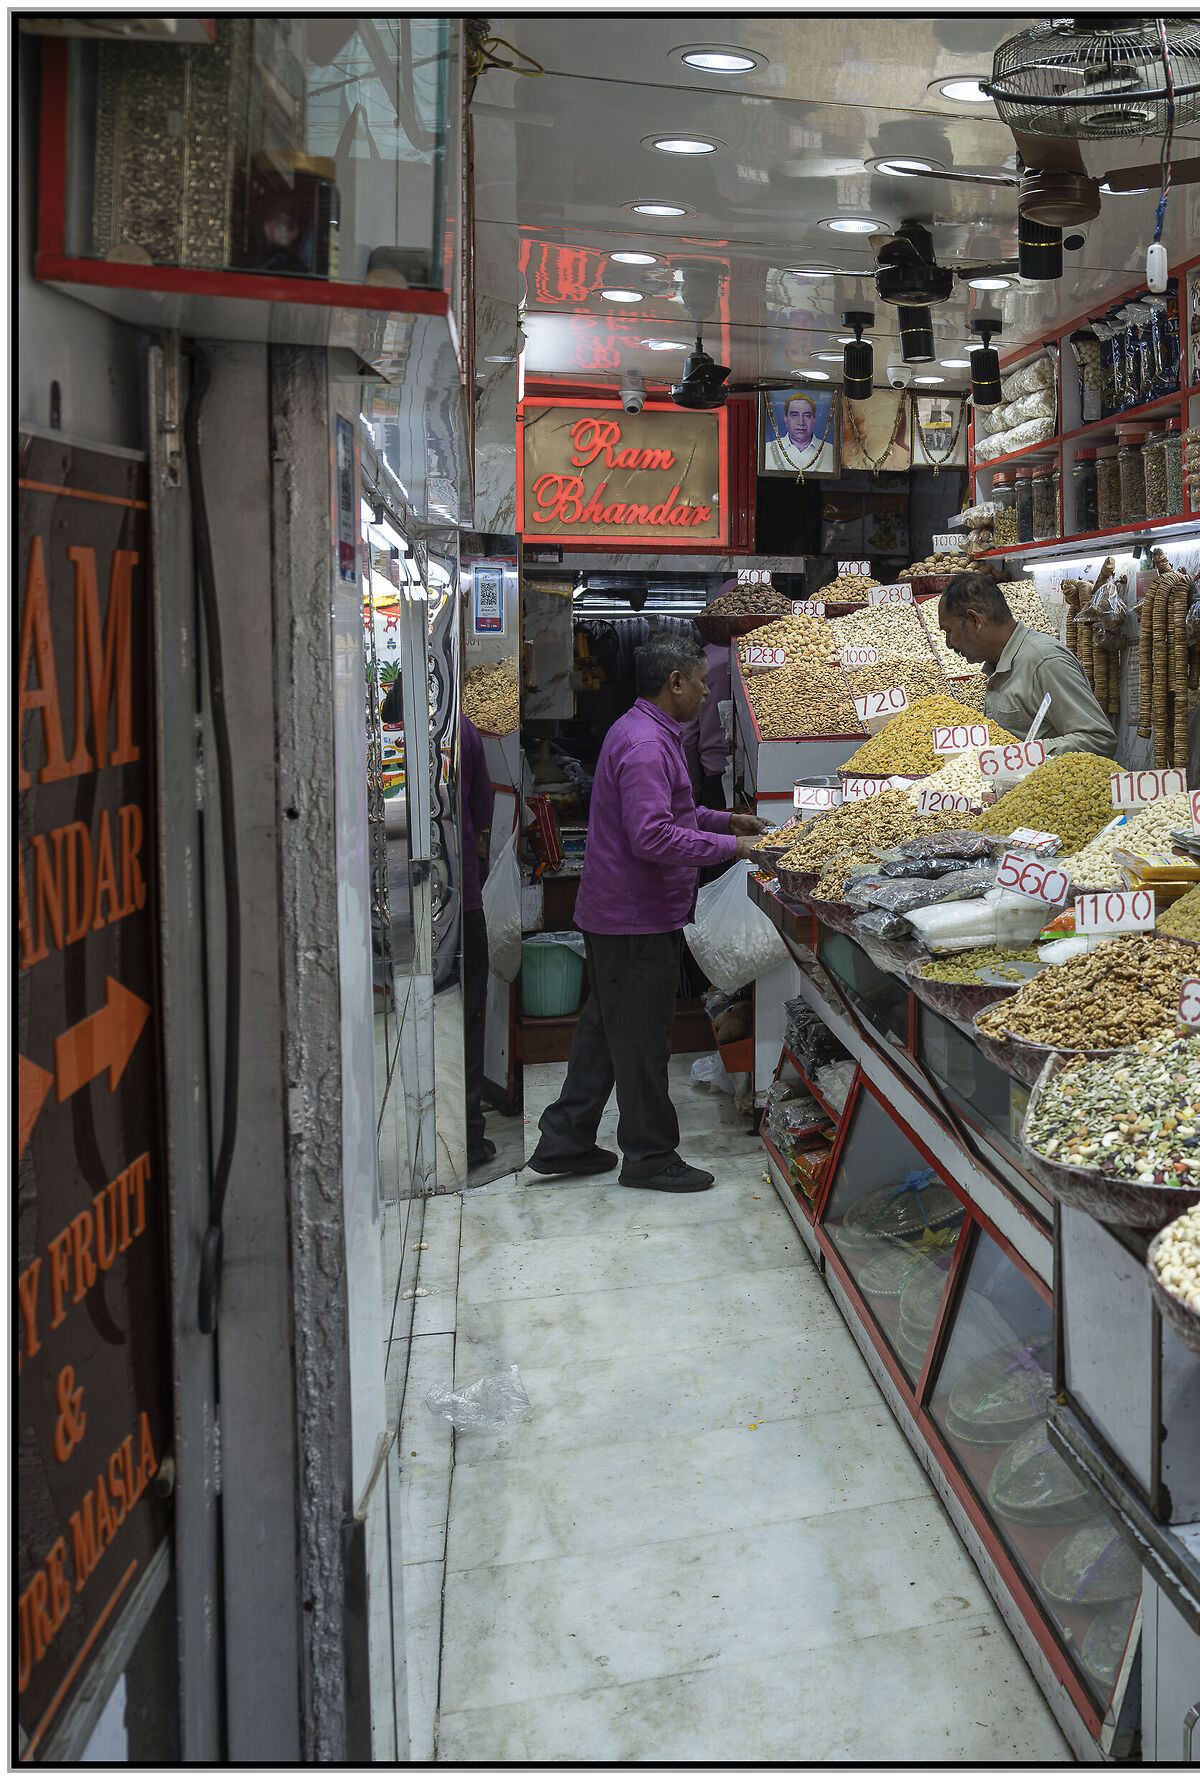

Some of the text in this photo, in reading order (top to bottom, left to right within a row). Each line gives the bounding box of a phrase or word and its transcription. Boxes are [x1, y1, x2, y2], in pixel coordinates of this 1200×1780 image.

[570, 417, 677, 471] Ram
[532, 472, 713, 527] Bhandar
[737, 569, 772, 585] 400
[837, 561, 871, 577] 400
[791, 600, 826, 618] 680
[869, 584, 914, 606] 1280
[745, 647, 786, 666] 1280
[844, 649, 878, 664] 1000
[857, 687, 907, 716] 720
[933, 725, 988, 751] 1200
[978, 740, 1046, 777] 680
[843, 778, 893, 797] 1400
[1111, 769, 1185, 803] 1100
[921, 790, 972, 812] 1200
[998, 853, 1068, 903] 560
[1076, 890, 1153, 926] 1100
[46, 1152, 151, 1331] FRUIT
[54, 1364, 87, 1464] &
[70, 1411, 158, 1595] MASLA
